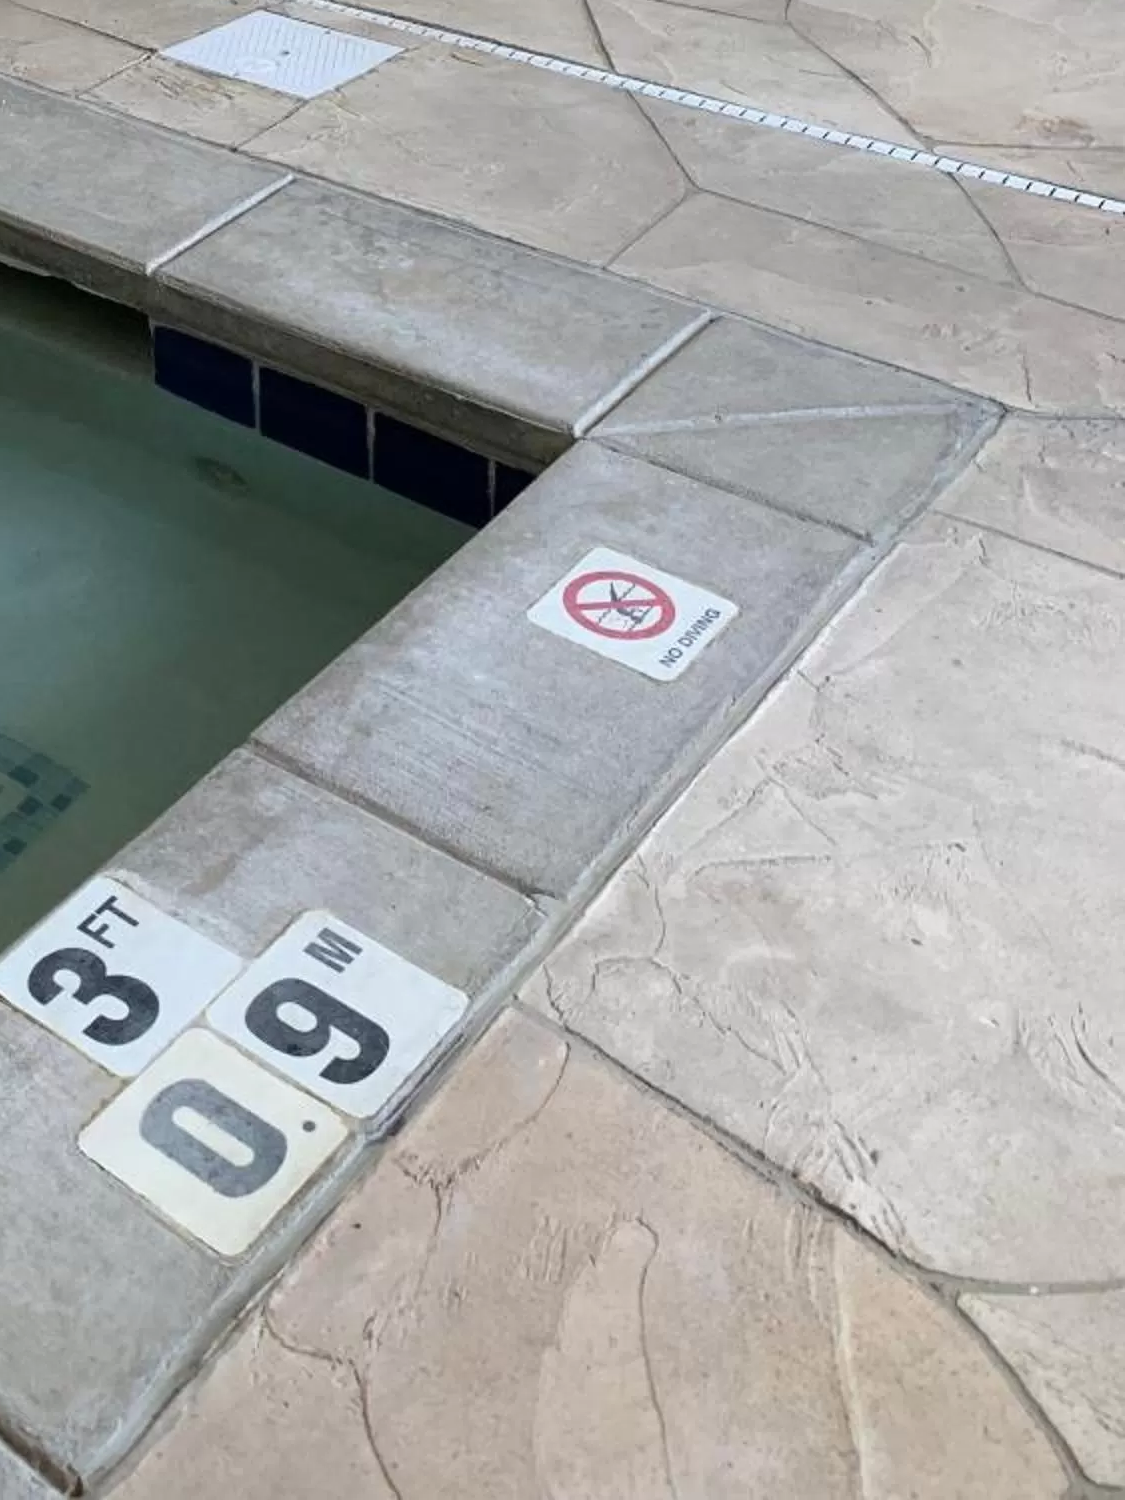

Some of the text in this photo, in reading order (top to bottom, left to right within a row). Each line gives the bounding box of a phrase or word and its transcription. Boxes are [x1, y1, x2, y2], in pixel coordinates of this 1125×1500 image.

[659, 607, 722, 668] NO DIVING
[27, 895, 160, 1046] 3 FT
[303, 927, 364, 973] M
